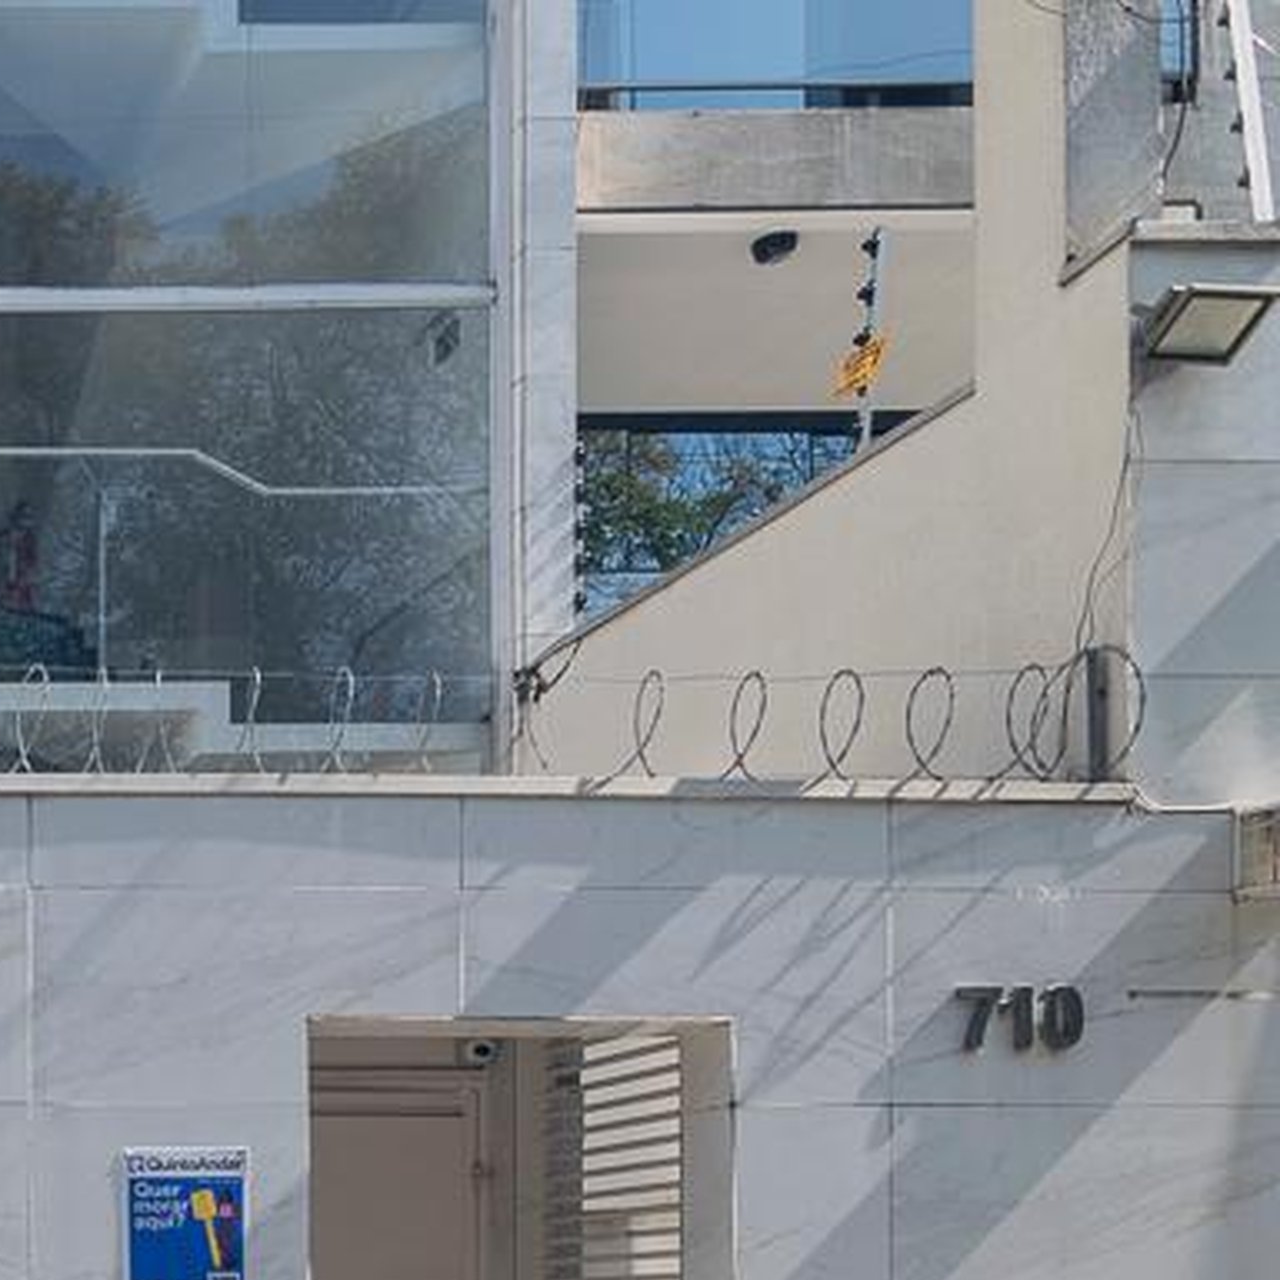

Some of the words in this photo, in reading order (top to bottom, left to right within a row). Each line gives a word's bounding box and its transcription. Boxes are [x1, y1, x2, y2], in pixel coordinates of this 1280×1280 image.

[954, 983, 1085, 1051] 710
[146, 1156, 242, 1171] QuintoAndar
[133, 1181, 180, 1198] Quer
